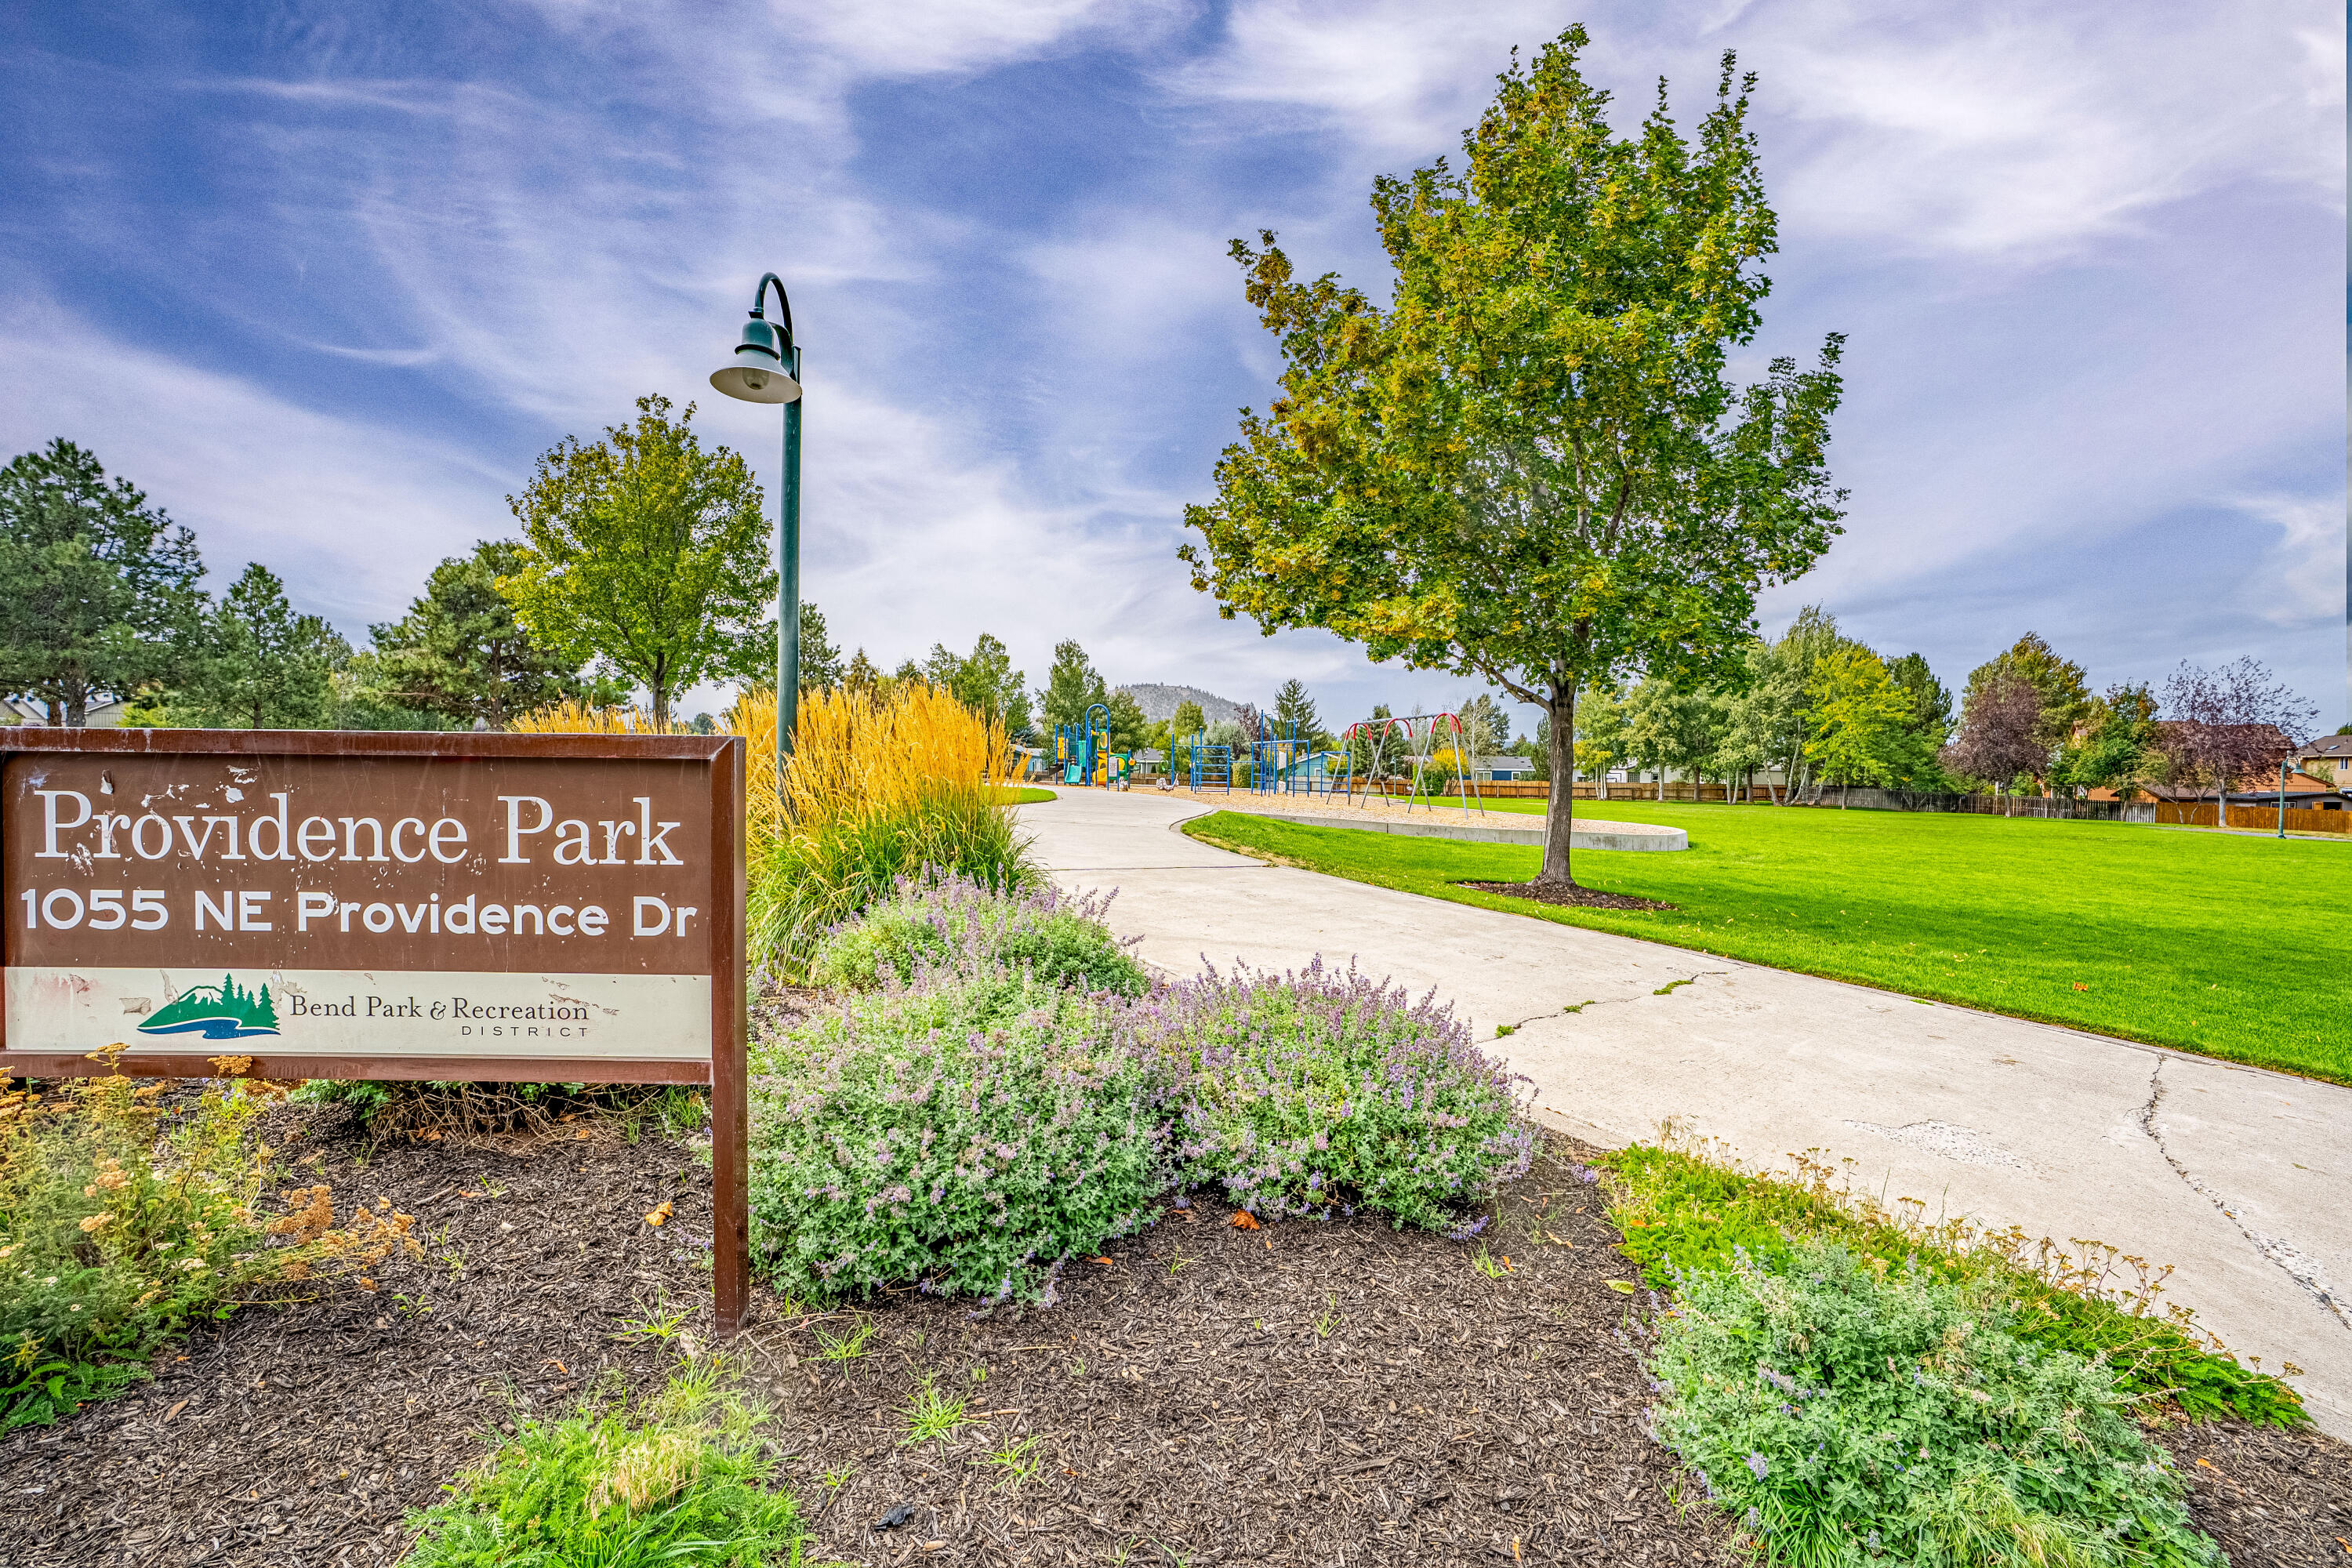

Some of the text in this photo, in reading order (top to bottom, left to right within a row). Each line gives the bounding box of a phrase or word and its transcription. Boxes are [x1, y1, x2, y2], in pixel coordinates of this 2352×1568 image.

[34, 789, 684, 866] Providence Park
[20, 887, 698, 938] 1055 NE Providence Dr
[289, 994, 590, 1021] Bend Park & Recreation
[461, 1025, 590, 1037] DISTRICT
